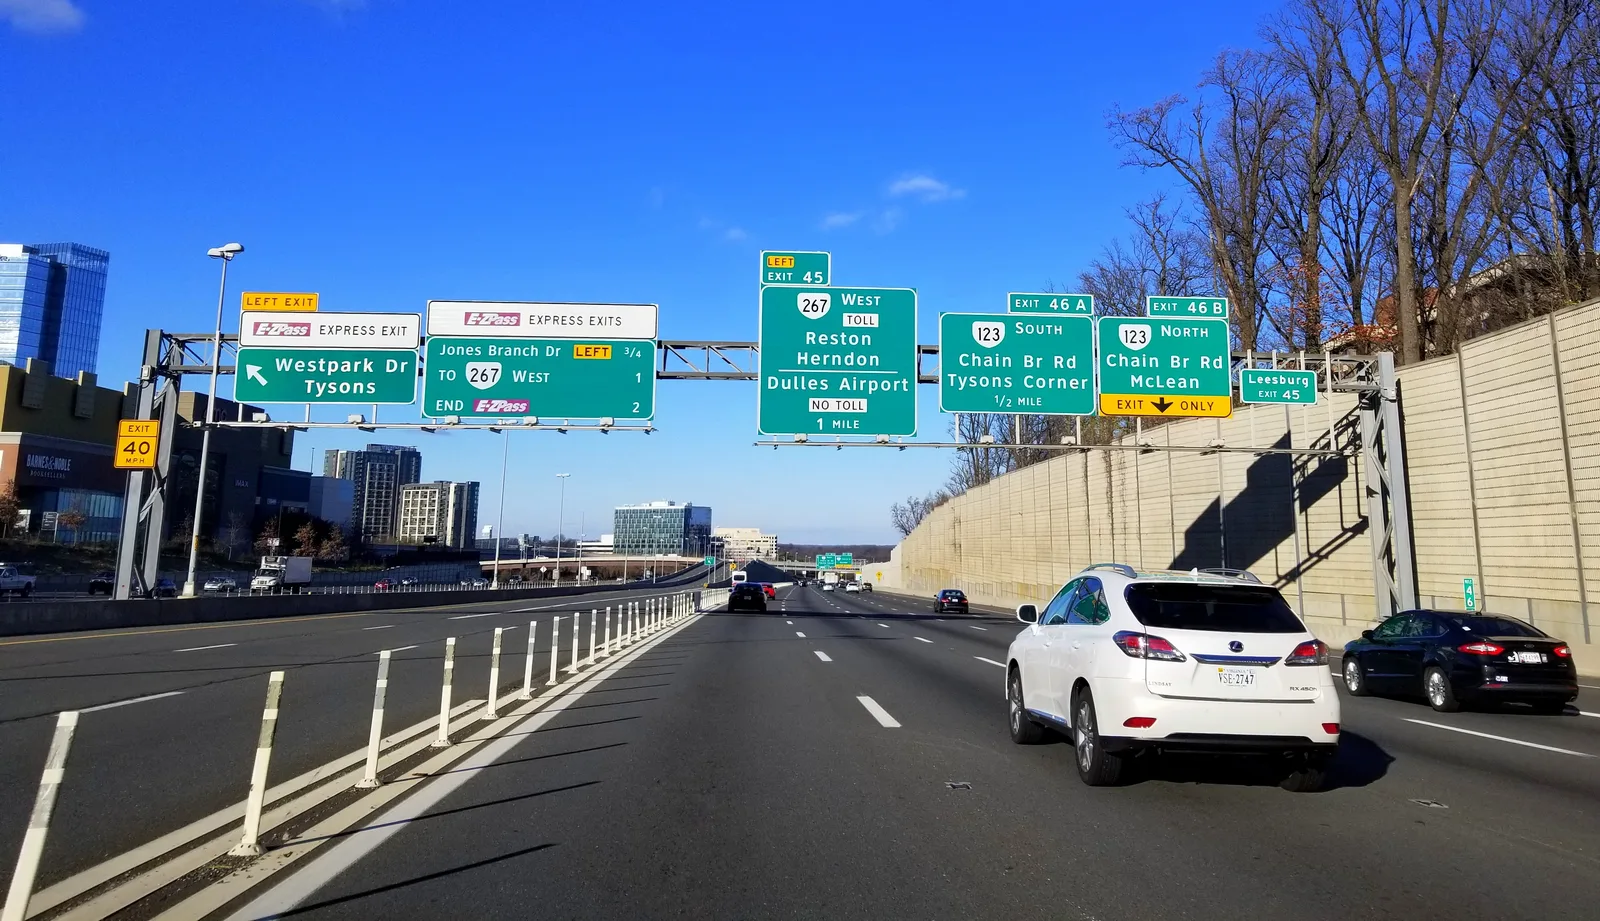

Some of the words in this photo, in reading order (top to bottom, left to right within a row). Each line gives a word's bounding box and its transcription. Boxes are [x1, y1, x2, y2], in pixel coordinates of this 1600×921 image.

[767, 257, 794, 266] LEFT
[768, 272, 793, 281] EXIT
[802, 271, 823, 284] 45
[246, 297, 278, 306] LEFT
[285, 297, 314, 307] EXIT
[802, 299, 828, 313] 267
[841, 293, 881, 306] WEST
[1015, 299, 1040, 308] EXIT
[1049, 298, 1070, 311] 46
[1075, 299, 1086, 311] A
[1153, 302, 1178, 311] EXIT
[1187, 302, 1208, 314] 46
[1213, 302, 1223, 314] B
[529, 314, 584, 326] EXPRESS
[589, 315, 622, 327] EXITS
[847, 315, 875, 326] TOLL
[319, 324, 376, 336] EXPRESS
[382, 325, 408, 336] EXIT
[977, 327, 1000, 342] 123
[1015, 322, 1063, 335] SOUTH
[1161, 324, 1209, 338] NORTH
[805, 331, 872, 346] Reston
[1124, 329, 1147, 344] 123
[439, 344, 482, 356] Jones
[488, 344, 539, 357] Branch
[545, 345, 561, 357] Dr
[576, 347, 609, 357] LEFT
[624, 347, 642, 359] 3/4
[797, 351, 880, 367] Herndon
[958, 353, 1012, 367] Chain
[1023, 355, 1043, 368] Br
[1054, 355, 1076, 369] Rd
[1106, 353, 1159, 368] Chain
[1170, 355, 1190, 369] Br
[1200, 355, 1223, 369] Rd
[275, 358, 374, 376] Westpark
[386, 359, 408, 373] Dr
[439, 369, 457, 381] TO
[470, 368, 499, 383] 267
[512, 370, 550, 383] WEST
[636, 372, 642, 384] 1
[1130, 374, 1199, 389] McLean
[1248, 373, 1309, 388] Leesburg
[304, 379, 376, 397] Tysons
[767, 375, 829, 390] Dulles
[839, 377, 909, 395] Airport
[947, 373, 1013, 391] Tysons
[1023, 375, 1088, 390] Corner
[994, 394, 1012, 407] 1/2
[1017, 397, 1042, 406] MILE
[1258, 390, 1278, 398] EXIT
[1282, 389, 1300, 400] 45
[435, 399, 464, 412] END
[632, 402, 640, 413] 2
[812, 400, 830, 410] NO
[836, 401, 864, 411] TOLL
[1117, 399, 1144, 410] EXIT
[1180, 400, 1214, 411] ONLY
[128, 424, 150, 433] EXIT
[816, 417, 823, 430] 1
[832, 419, 860, 429] MILE
[123, 441, 150, 455] 40
[1218, 672, 1254, 685] VSE-2747
